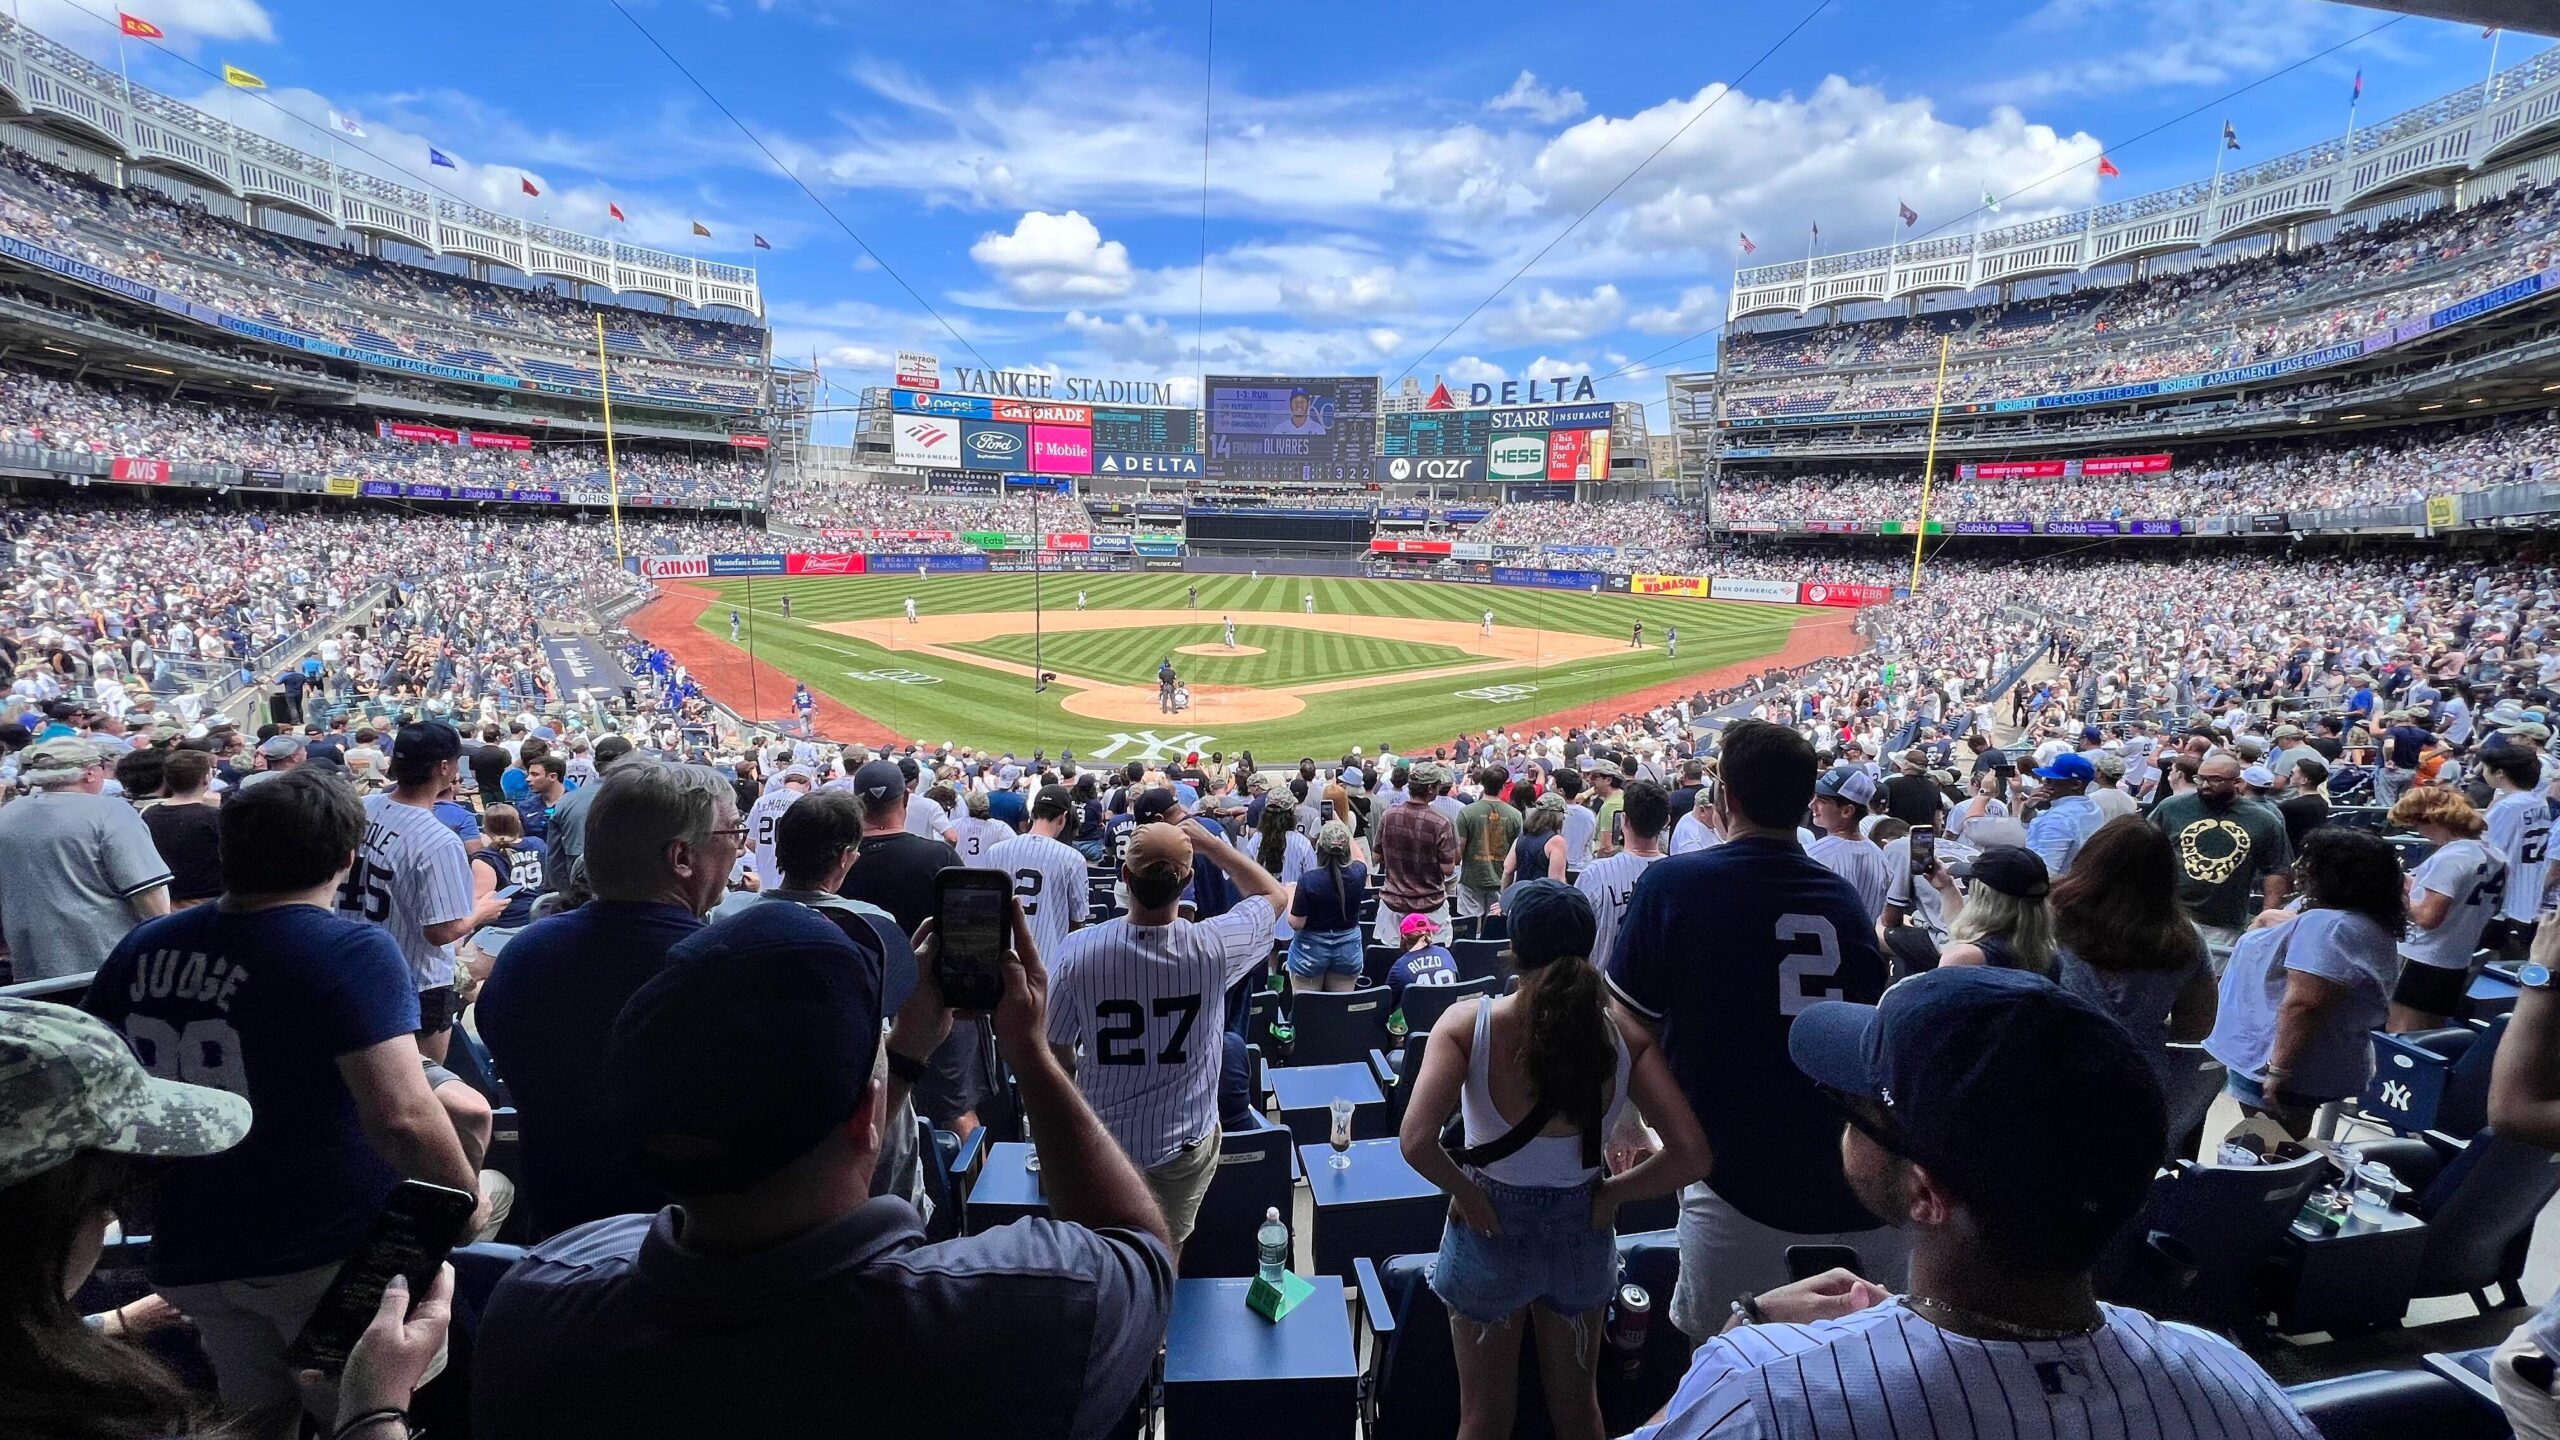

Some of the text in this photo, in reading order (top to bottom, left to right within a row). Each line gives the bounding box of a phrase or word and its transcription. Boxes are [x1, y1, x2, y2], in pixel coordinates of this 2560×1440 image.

[0, 236, 153, 300] APARTMENT LEASE GUARANTY
[2434, 278, 2537, 327] WE CLOSE THE DEAL
[232, 320, 260, 336] CLOSE
[262, 328, 279, 341] THE
[280, 332, 301, 347] DEAL
[898, 353, 936, 364] ARMITRON
[344, 348, 398, 366] APARTMENT
[400, 360, 427, 372] LEASE
[429, 364, 479, 381] GUARANTY
[485, 374, 519, 388] INSURENT
[902, 376, 936, 384] ARMITRON
[1996, 344, 2361, 412] INSURENT WE CLOSE THE DEAL INSURENT APARTMENT LEASE GUARANTY
[954, 367, 1172, 406] YANKEE STADIUM
[1471, 376, 1596, 406] DELTA
[1252, 390, 1268, 399] RUN
[934, 400, 972, 413] pepsi
[1000, 404, 1085, 422] GATORADE
[1492, 410, 1610, 428] STARR INSURANCE
[1813, 413, 1847, 422] Mastercard
[1862, 413, 1873, 421] get
[1913, 410, 1931, 418] game
[976, 434, 1012, 450] Ford
[1552, 433, 1572, 442] This
[1046, 443, 1087, 457] Mobile
[1209, 434, 1309, 458] 14 OLIVARES
[1552, 442, 1576, 451] Bud's
[1494, 449, 1541, 464] HESS
[1552, 452, 1566, 460] For
[126, 462, 158, 480] AVIS
[1126, 456, 1196, 473] DELTA
[1417, 460, 1472, 478] razr
[1552, 461, 1569, 469] You.
[1336, 468, 1343, 479] 3
[1349, 468, 1356, 479] 2
[1363, 468, 1370, 479] 2
[368, 483, 391, 494] StubHub
[414, 487, 442, 497] StubHub
[465, 488, 495, 499] StubHub
[520, 492, 551, 502] StubHub
[578, 493, 609, 504] ORIS
[714, 499, 732, 508] Poland
[1729, 521, 1779, 530] Parts Authority
[1958, 523, 1996, 533] StubHub
[2049, 523, 2086, 534] StubHub
[2143, 523, 2170, 534] StubHub
[964, 536, 982, 544] Uber
[984, 536, 1003, 544] Eats
[1103, 536, 1126, 545] coupa
[642, 558, 707, 576] Canon
[752, 558, 780, 566] Einstein
[807, 558, 848, 568] Budweiser
[1852, 588, 1882, 598] WEBB
[1088, 730, 1218, 760] NY
[366, 822, 400, 856] OLE
[967, 837, 980, 856] 3
[510, 862, 543, 892] 99
[336, 856, 395, 923] 45
[1014, 868, 1043, 916] 2
[1407, 956, 1442, 974] RIZZO
[1775, 913, 1844, 1016] 2
[129, 948, 250, 1013] JUDGE
[1096, 994, 1202, 1066] 27
[2380, 1079, 2412, 1112] NY
